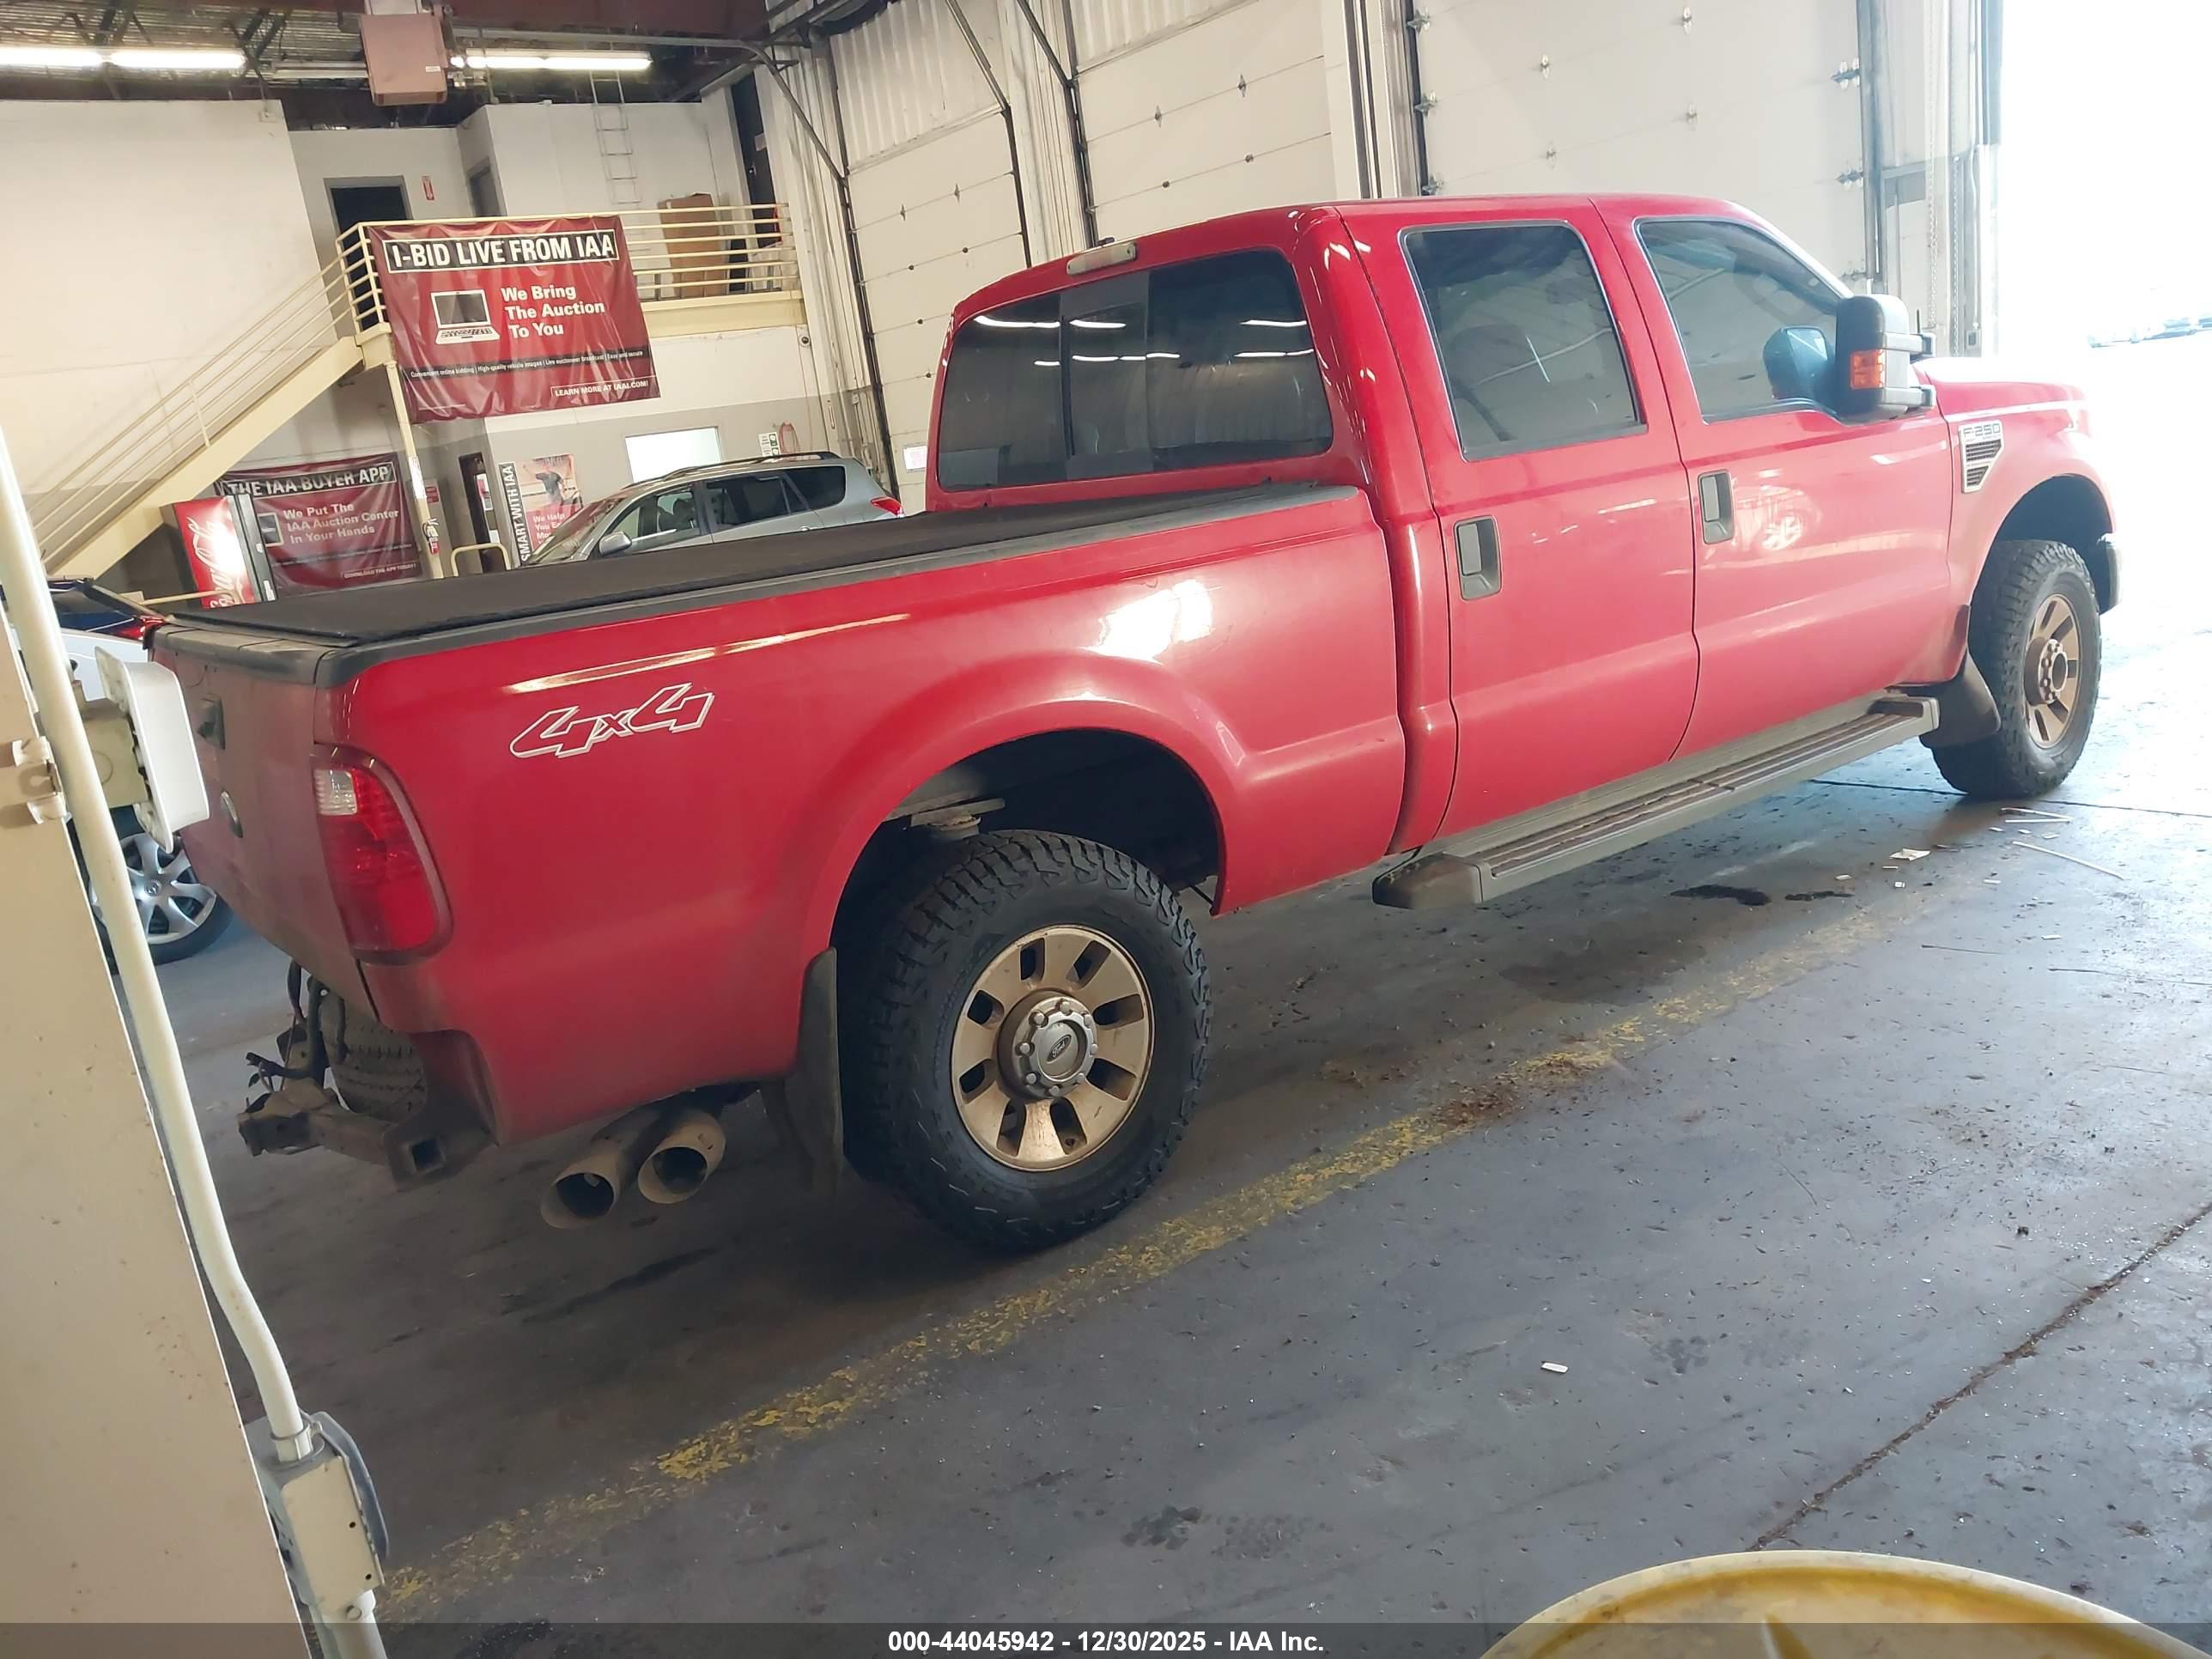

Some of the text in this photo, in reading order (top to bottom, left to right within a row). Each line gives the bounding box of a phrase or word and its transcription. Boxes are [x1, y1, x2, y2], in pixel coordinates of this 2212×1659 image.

[392, 234, 615, 267] I-BID LIVE FROM IAA
[501, 285, 576, 301] We Bring
[505, 301, 605, 320] The Auction
[507, 323, 563, 338] To You
[580, 386, 602, 394] MORE
[1963, 422, 2001, 437] F-250
[228, 466, 390, 496] THE IAA BUYER APP
[283, 503, 355, 520] We Put The
[287, 510, 399, 532] IAA Auction Center
[501, 465, 531, 562] SMART WITH IAA
[547, 513, 565, 521] Help
[290, 525, 375, 544] In Your Hands
[510, 683, 714, 758] 4x4
